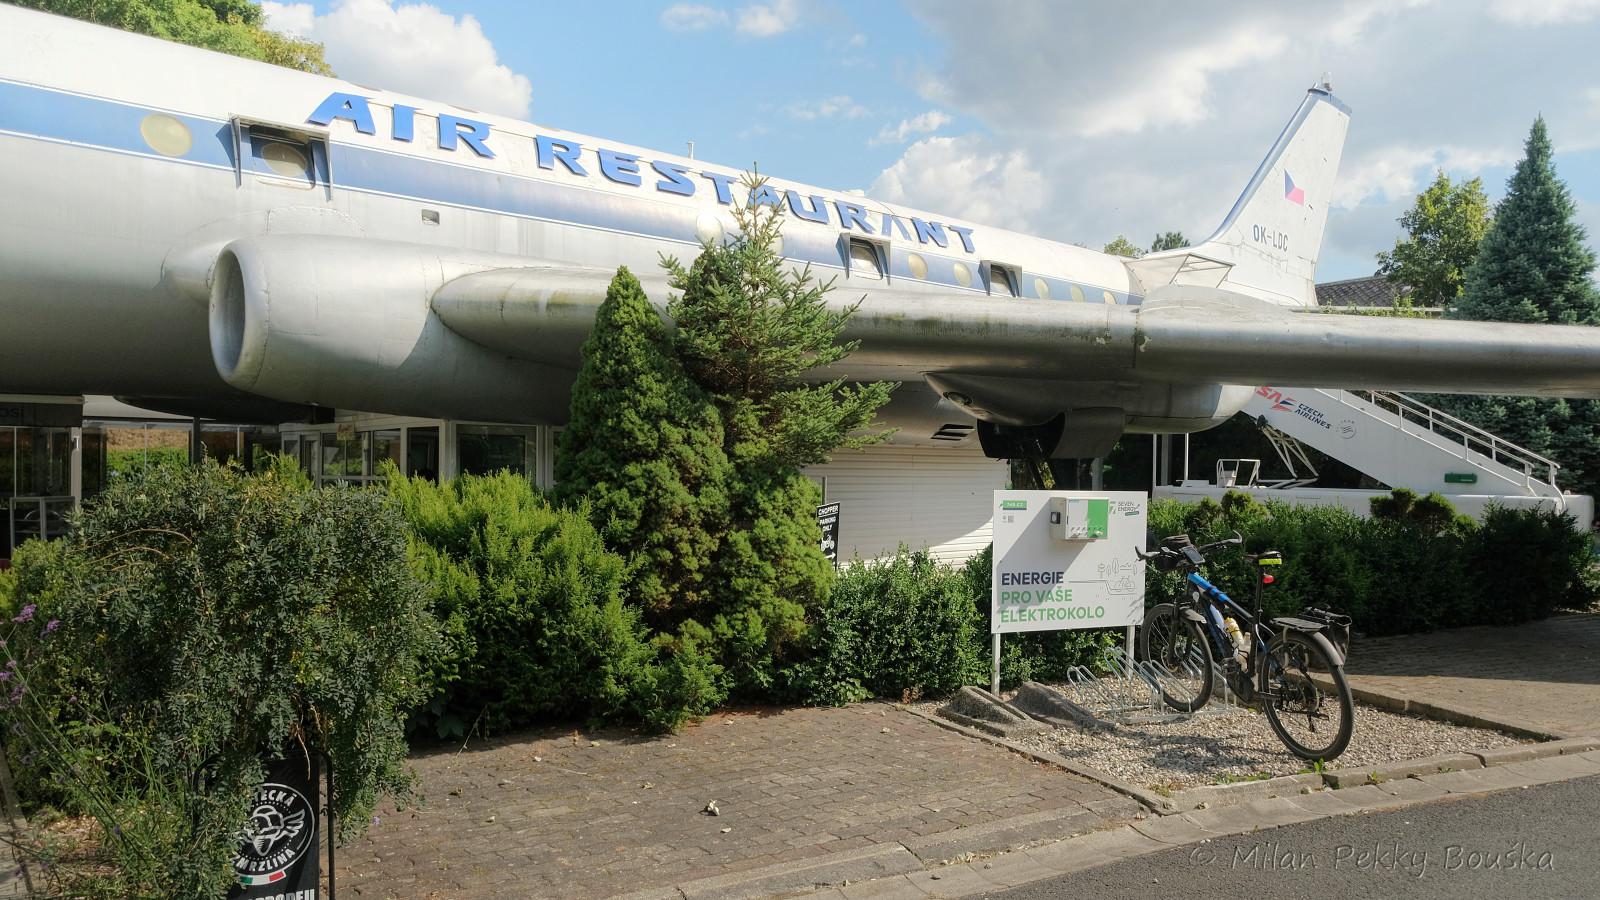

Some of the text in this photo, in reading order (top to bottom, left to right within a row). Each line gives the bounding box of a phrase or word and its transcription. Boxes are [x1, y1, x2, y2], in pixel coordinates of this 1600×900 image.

[305, 91, 976, 254] AIR RESTAURANT
[1253, 224, 1288, 252] OK-LDC
[1295, 409, 1332, 430] AIRLINES
[1298, 403, 1324, 418] CZECH
[819, 505, 838, 515] CHOPPER
[820, 516, 836, 525] PARKING
[1001, 572, 1065, 586] ENERGIE
[1001, 585, 1073, 604] PRO VAŠE
[1000, 605, 1105, 623] ELEKTROKOLO
